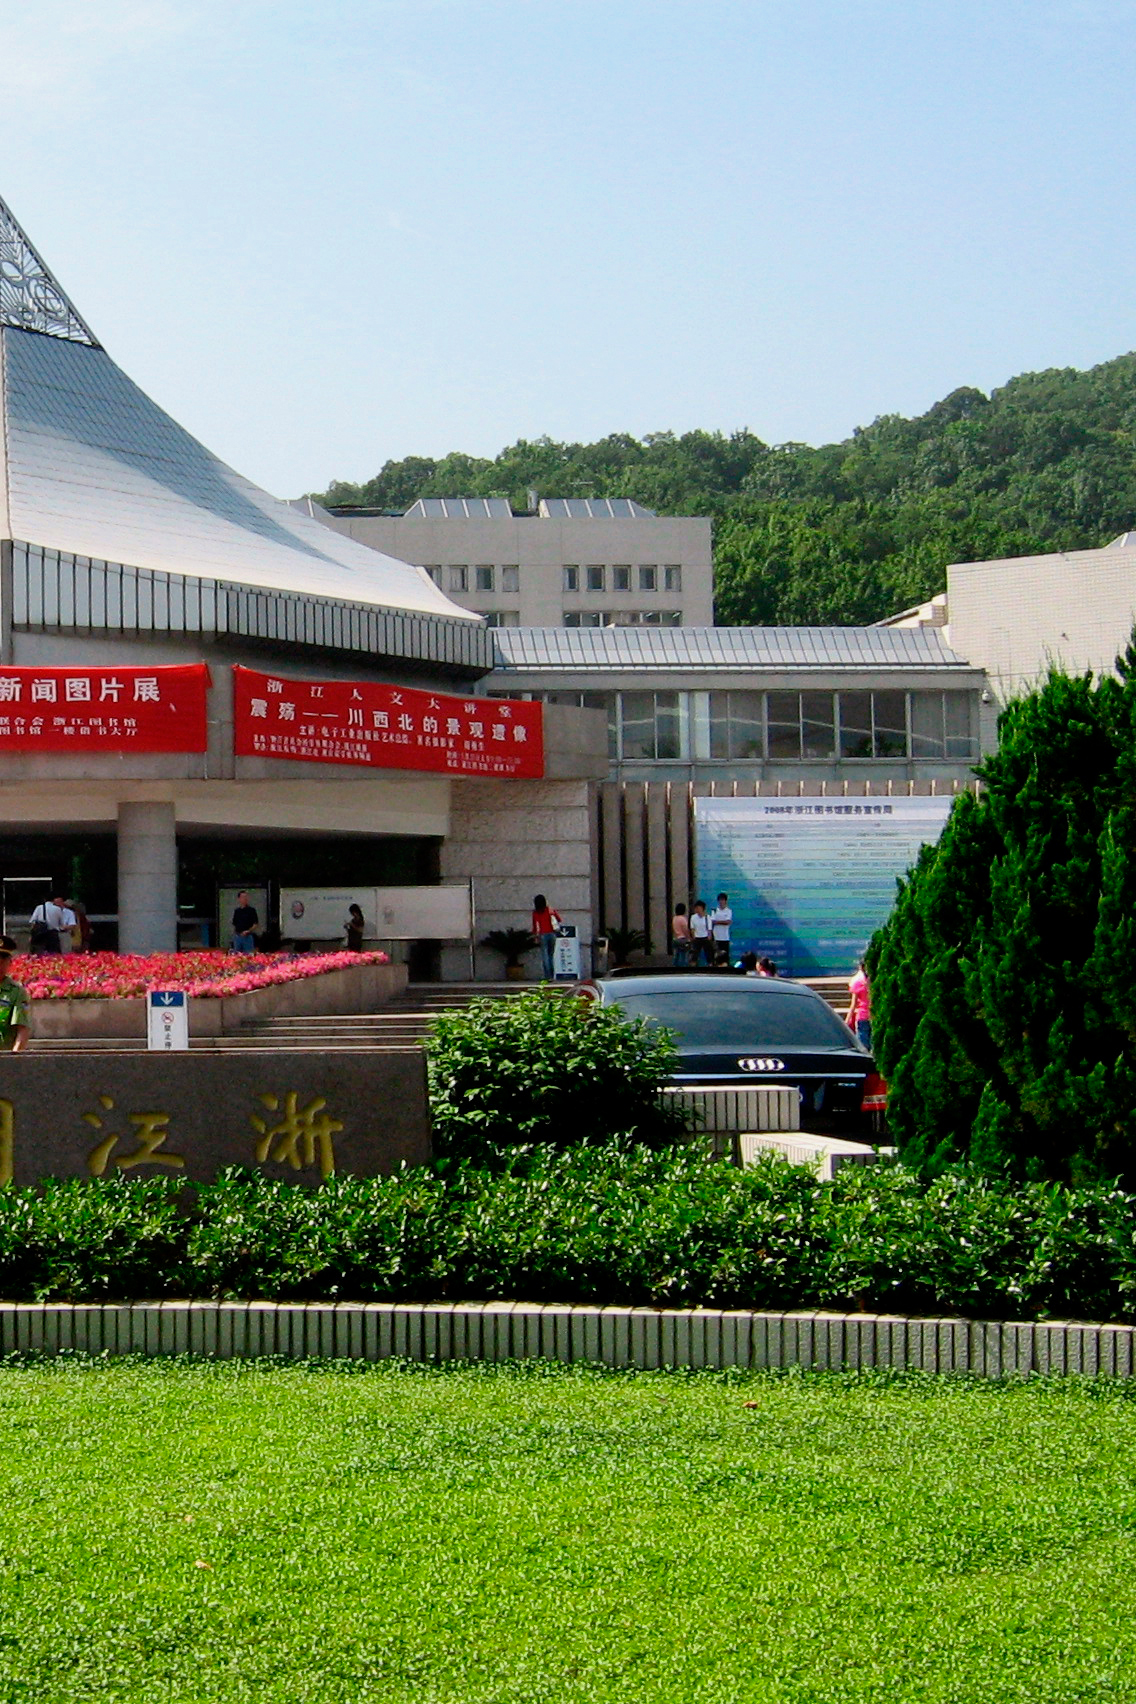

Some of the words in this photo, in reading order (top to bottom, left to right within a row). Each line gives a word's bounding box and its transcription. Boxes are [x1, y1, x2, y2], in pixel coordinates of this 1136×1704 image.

[266, 678, 513, 718] 浙江人文大讲堂
